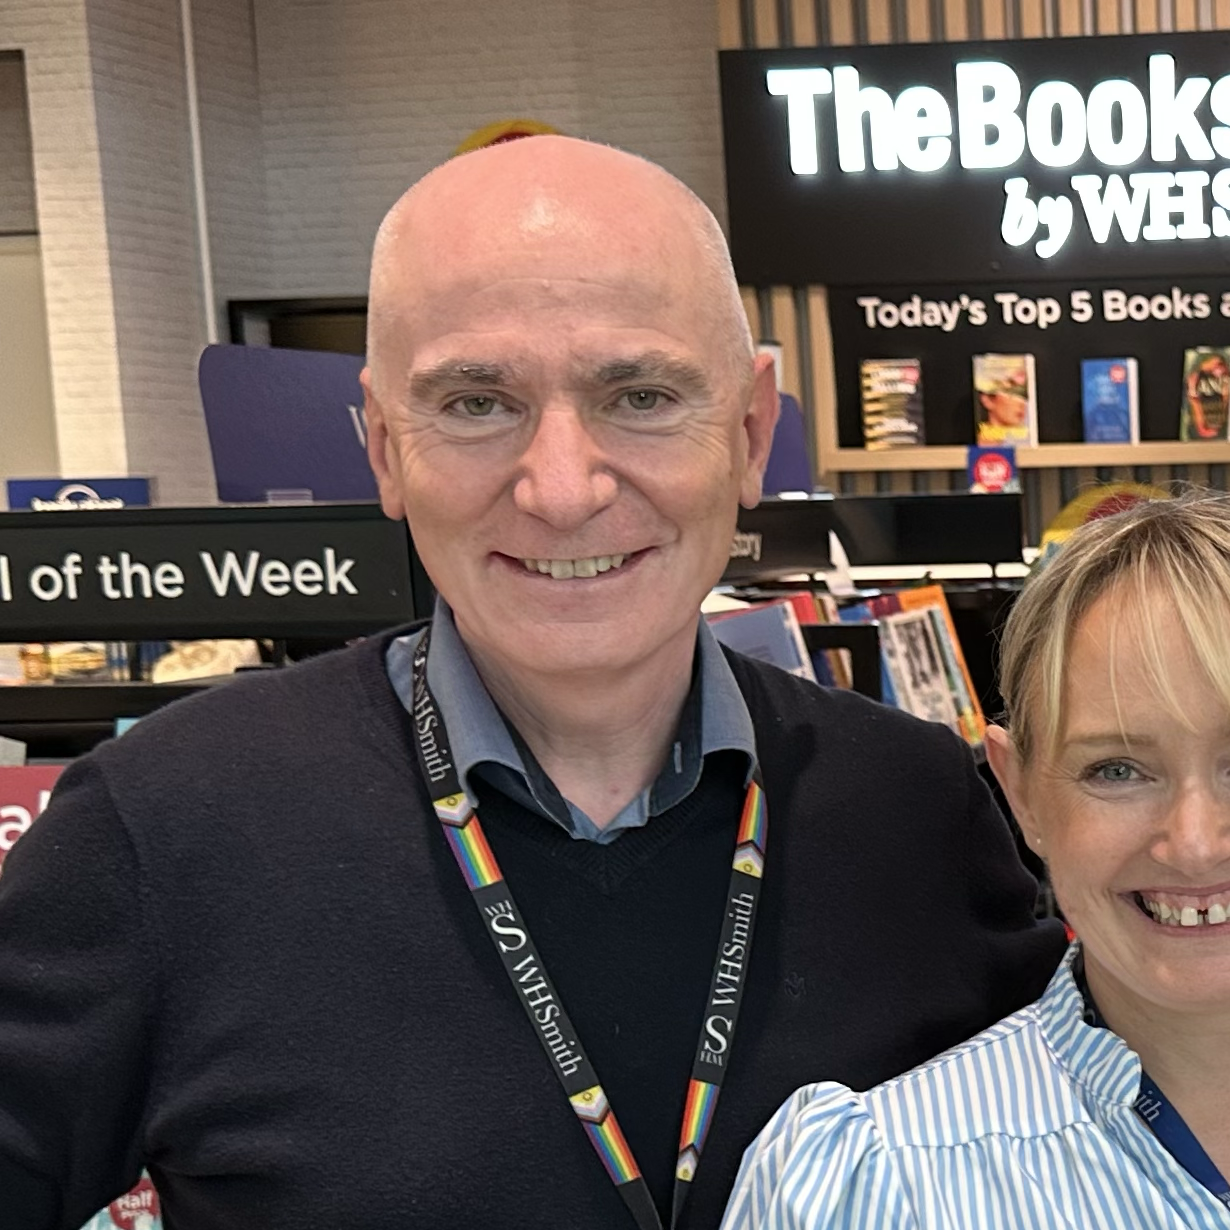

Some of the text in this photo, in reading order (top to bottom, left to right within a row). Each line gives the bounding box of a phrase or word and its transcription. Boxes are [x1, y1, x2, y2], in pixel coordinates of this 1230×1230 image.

[1000, 177, 1076, 258] by
[856, 294, 988, 331] Today's
[993, 291, 1062, 329] Top
[1070, 288, 1094, 323] 5
[1102, 286, 1211, 321] Books
[30, 553, 82, 601] of
[97, 551, 185, 600] the
[201, 549, 358, 598] Week
[712, 892, 755, 1008] WHSmith
[512, 955, 583, 1077] WHSmith
